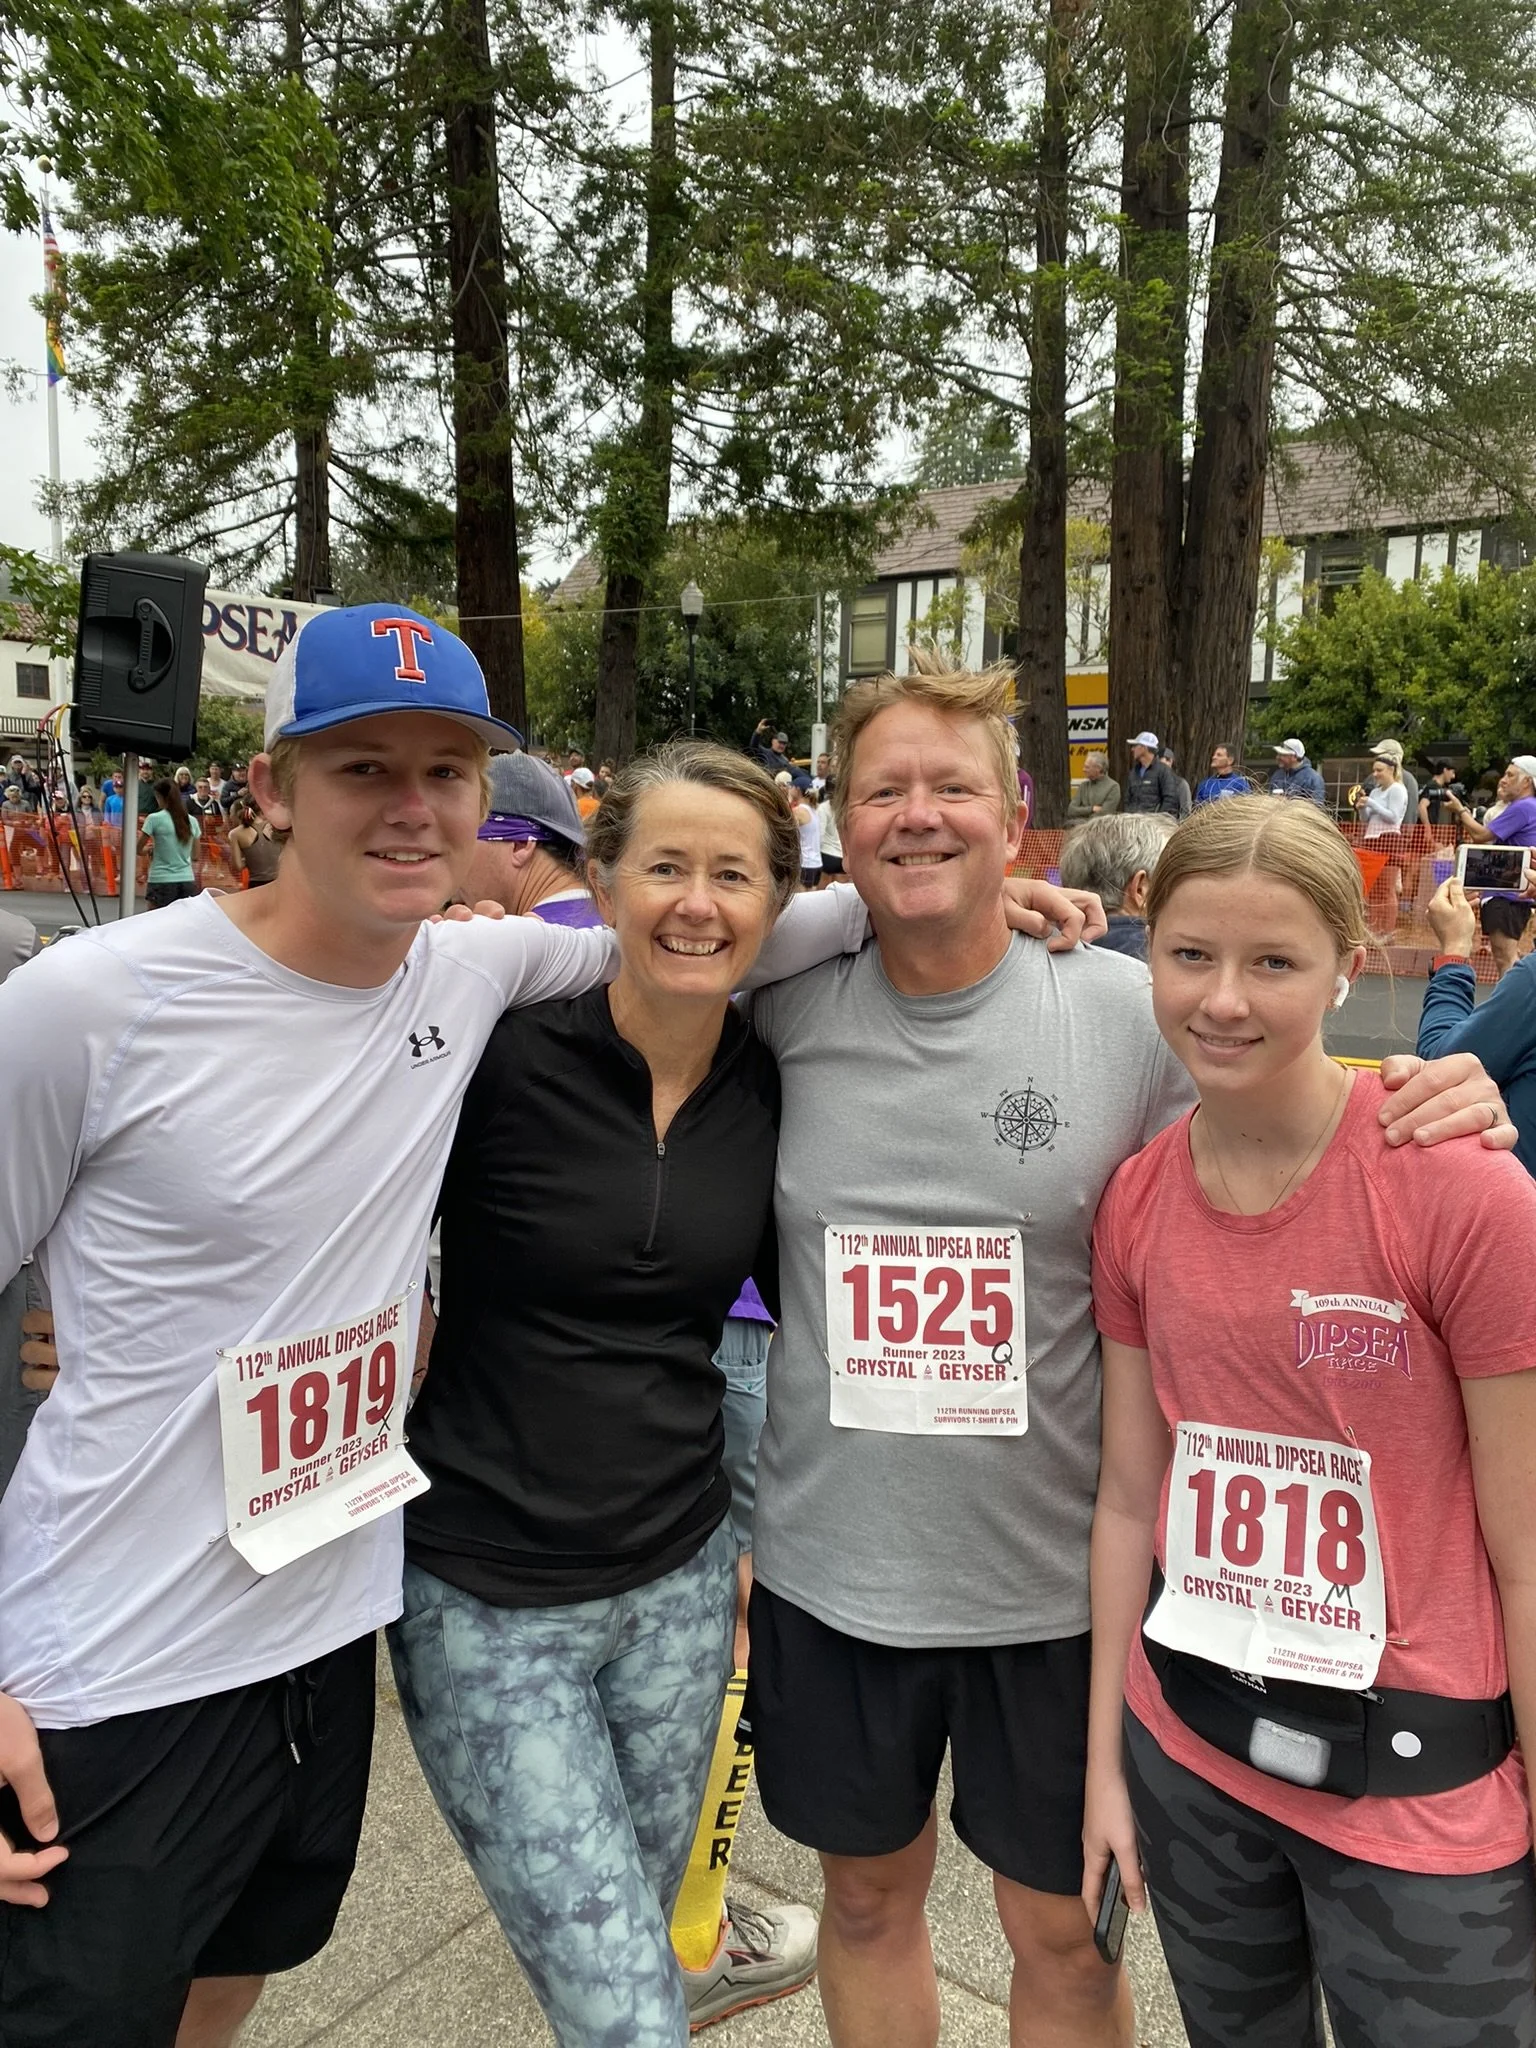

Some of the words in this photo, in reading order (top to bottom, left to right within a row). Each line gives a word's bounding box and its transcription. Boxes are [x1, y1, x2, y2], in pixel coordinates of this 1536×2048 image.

[371, 617, 434, 684] T
[840, 1234, 868, 1255] 112th
[872, 1235, 922, 1258] ANNUAL
[926, 1236, 972, 1259] DIPSEA
[977, 1238, 1011, 1260] RACE
[842, 1264, 1014, 1347] 1525
[1314, 1298, 1340, 1309] 109th
[1341, 1298, 1390, 1315] ANNUAL
[236, 1352, 273, 1381] 112th
[277, 1335, 331, 1373] ANNUAL
[335, 1318, 374, 1354] DIPSEA
[376, 1304, 399, 1336] RACE
[883, 1347, 928, 1360] Runner
[933, 1349, 966, 1361] 2023
[1295, 1319, 1412, 1381] DIPSEA
[846, 1358, 917, 1379] CRYSTAL
[939, 1363, 1006, 1381] GEYSER
[246, 1340, 396, 1475] 1819
[933, 1416, 971, 1424] SURVIVORS
[249, 1472, 320, 1517] CRYSTAL
[339, 1434, 388, 1476] GEYSER
[290, 1453, 332, 1480] Runner
[335, 1437, 362, 1459] 2023
[1186, 1431, 1212, 1458] 112th
[1216, 1436, 1272, 1468] ANNUAL
[1275, 1445, 1326, 1477] DIPSEA
[1331, 1454, 1363, 1486] RACE
[362, 1482, 390, 1500] RUNNING
[389, 1471, 410, 1485] DIPSEA
[1188, 1469, 1366, 1586] 1818
[1220, 1567, 1269, 1589] Runner
[1274, 1578, 1313, 1597] 2023
[1183, 1575, 1256, 1610] CRYSTAL
[1281, 1596, 1361, 1631] GEYSER
[1266, 1656, 1309, 1671] SURVIVORS
[1310, 1665, 1340, 1676] T-SHIRT
[1348, 1671, 1364, 1680] PIN
[1273, 1647, 1297, 1659] 112TH
[1297, 1653, 1333, 1666] RUNNING
[1335, 1659, 1363, 1671] DIPSEA
[1232, 1674, 1267, 1694] NATHAN
